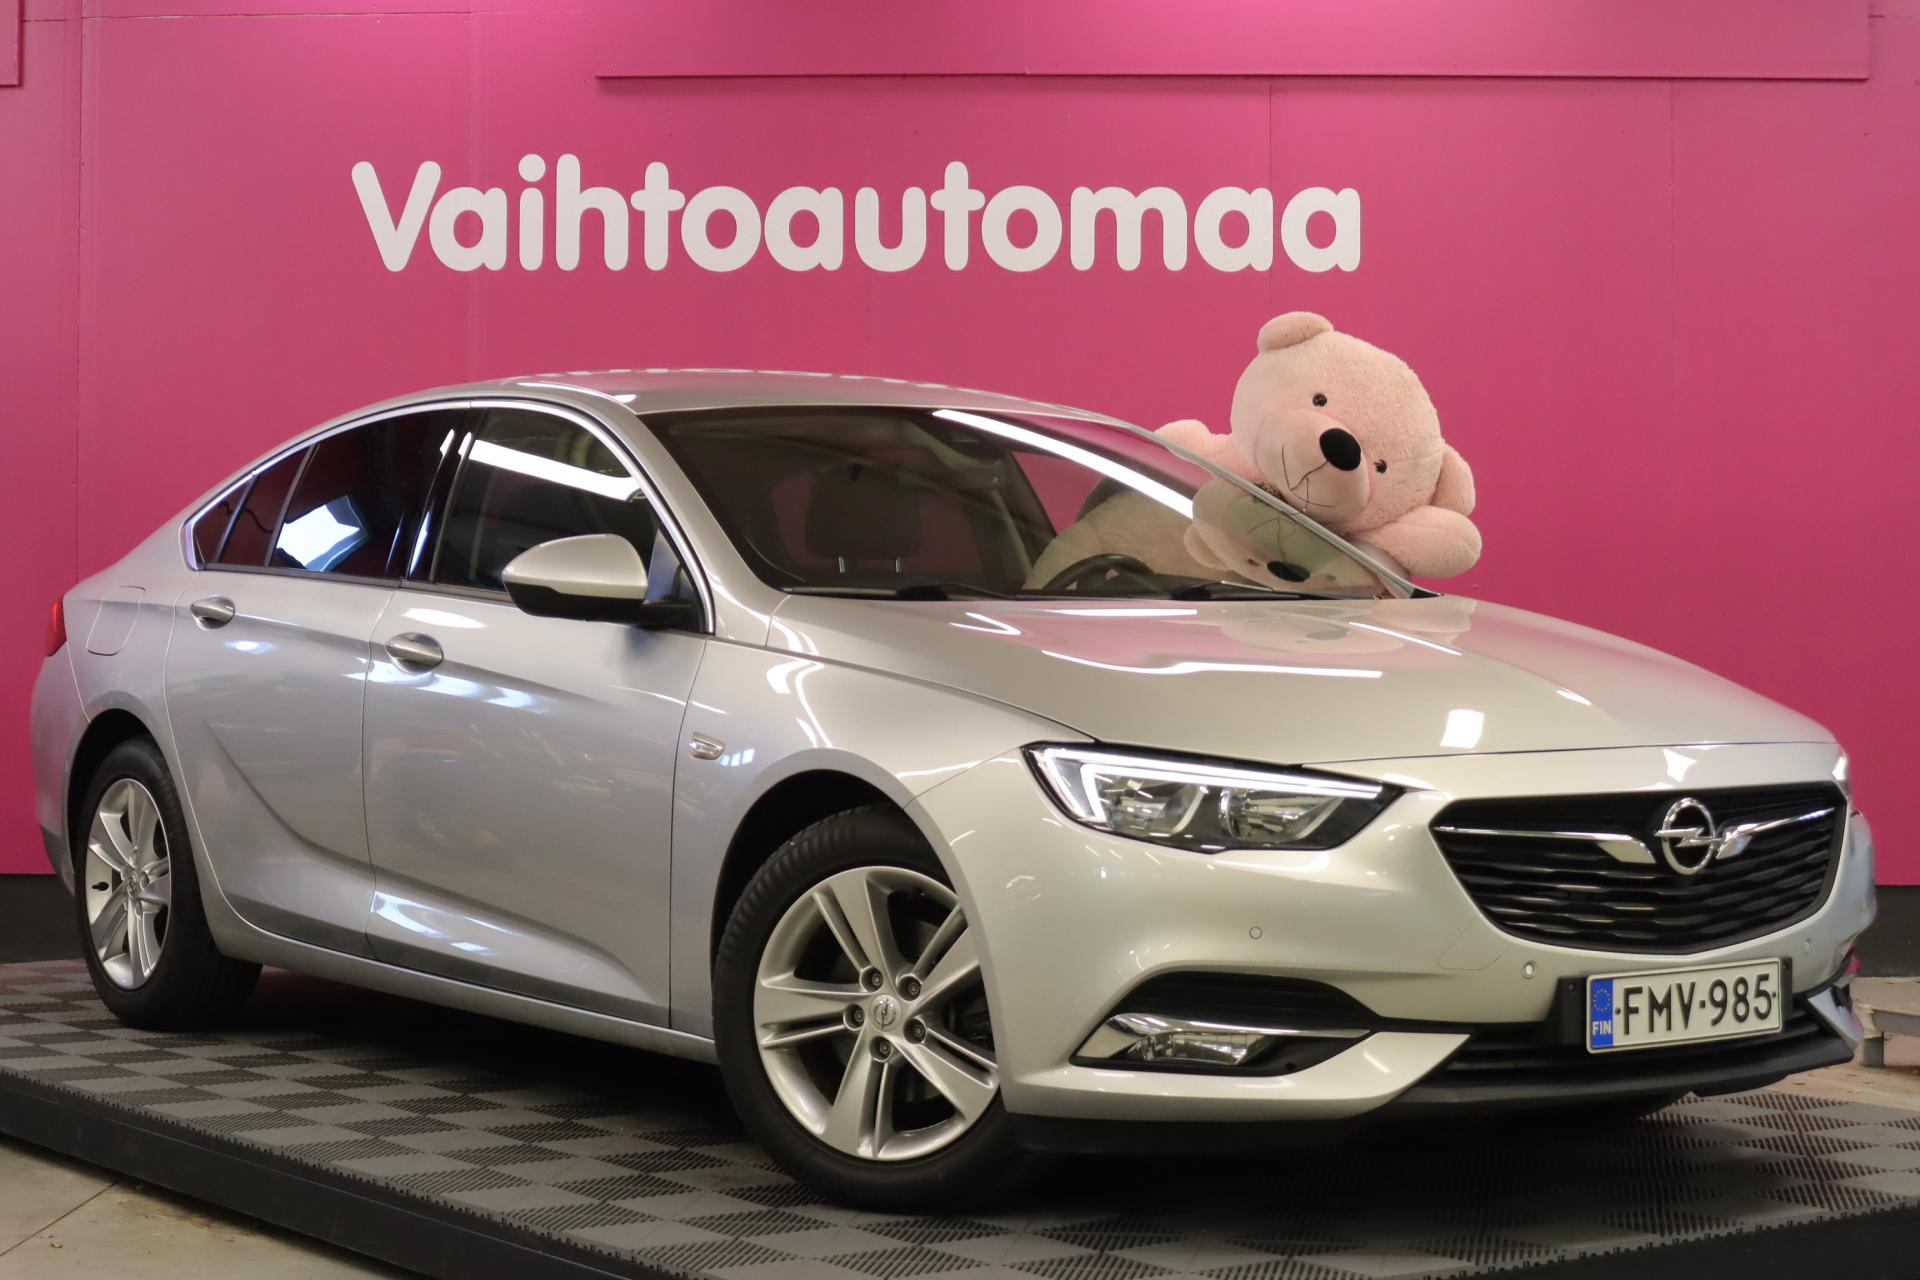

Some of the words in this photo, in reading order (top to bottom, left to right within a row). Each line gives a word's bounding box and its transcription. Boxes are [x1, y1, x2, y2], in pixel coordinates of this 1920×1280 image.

[351, 153, 1361, 272] Vaihtoautomaa
[1593, 1020, 1612, 1035] FIN
[1624, 973, 1772, 1035] FMV-985
